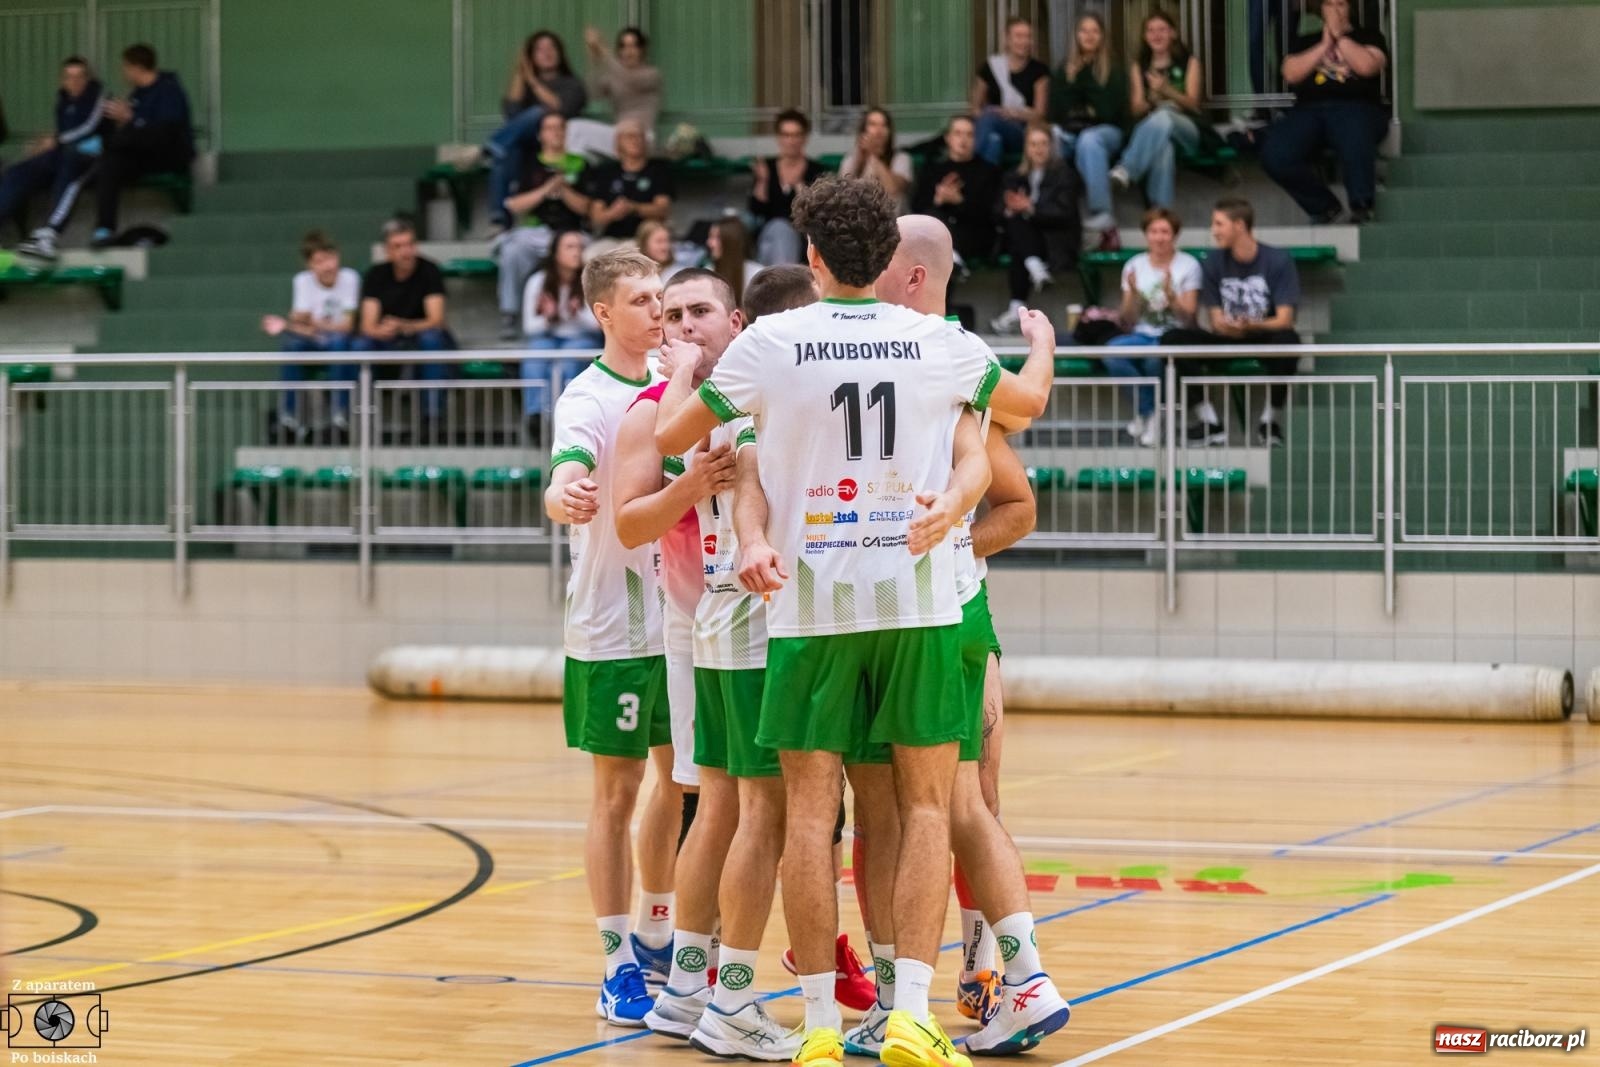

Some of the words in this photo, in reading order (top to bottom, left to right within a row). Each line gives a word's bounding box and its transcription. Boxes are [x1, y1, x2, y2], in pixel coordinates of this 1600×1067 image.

[794, 341, 921, 366] JAKUBOWSKI
[830, 382, 896, 461] 11
[806, 485, 834, 497] radio
[805, 541, 857, 549] UBEZPIECZENIA
[616, 693, 640, 731] 3
[652, 905, 669, 917] R
